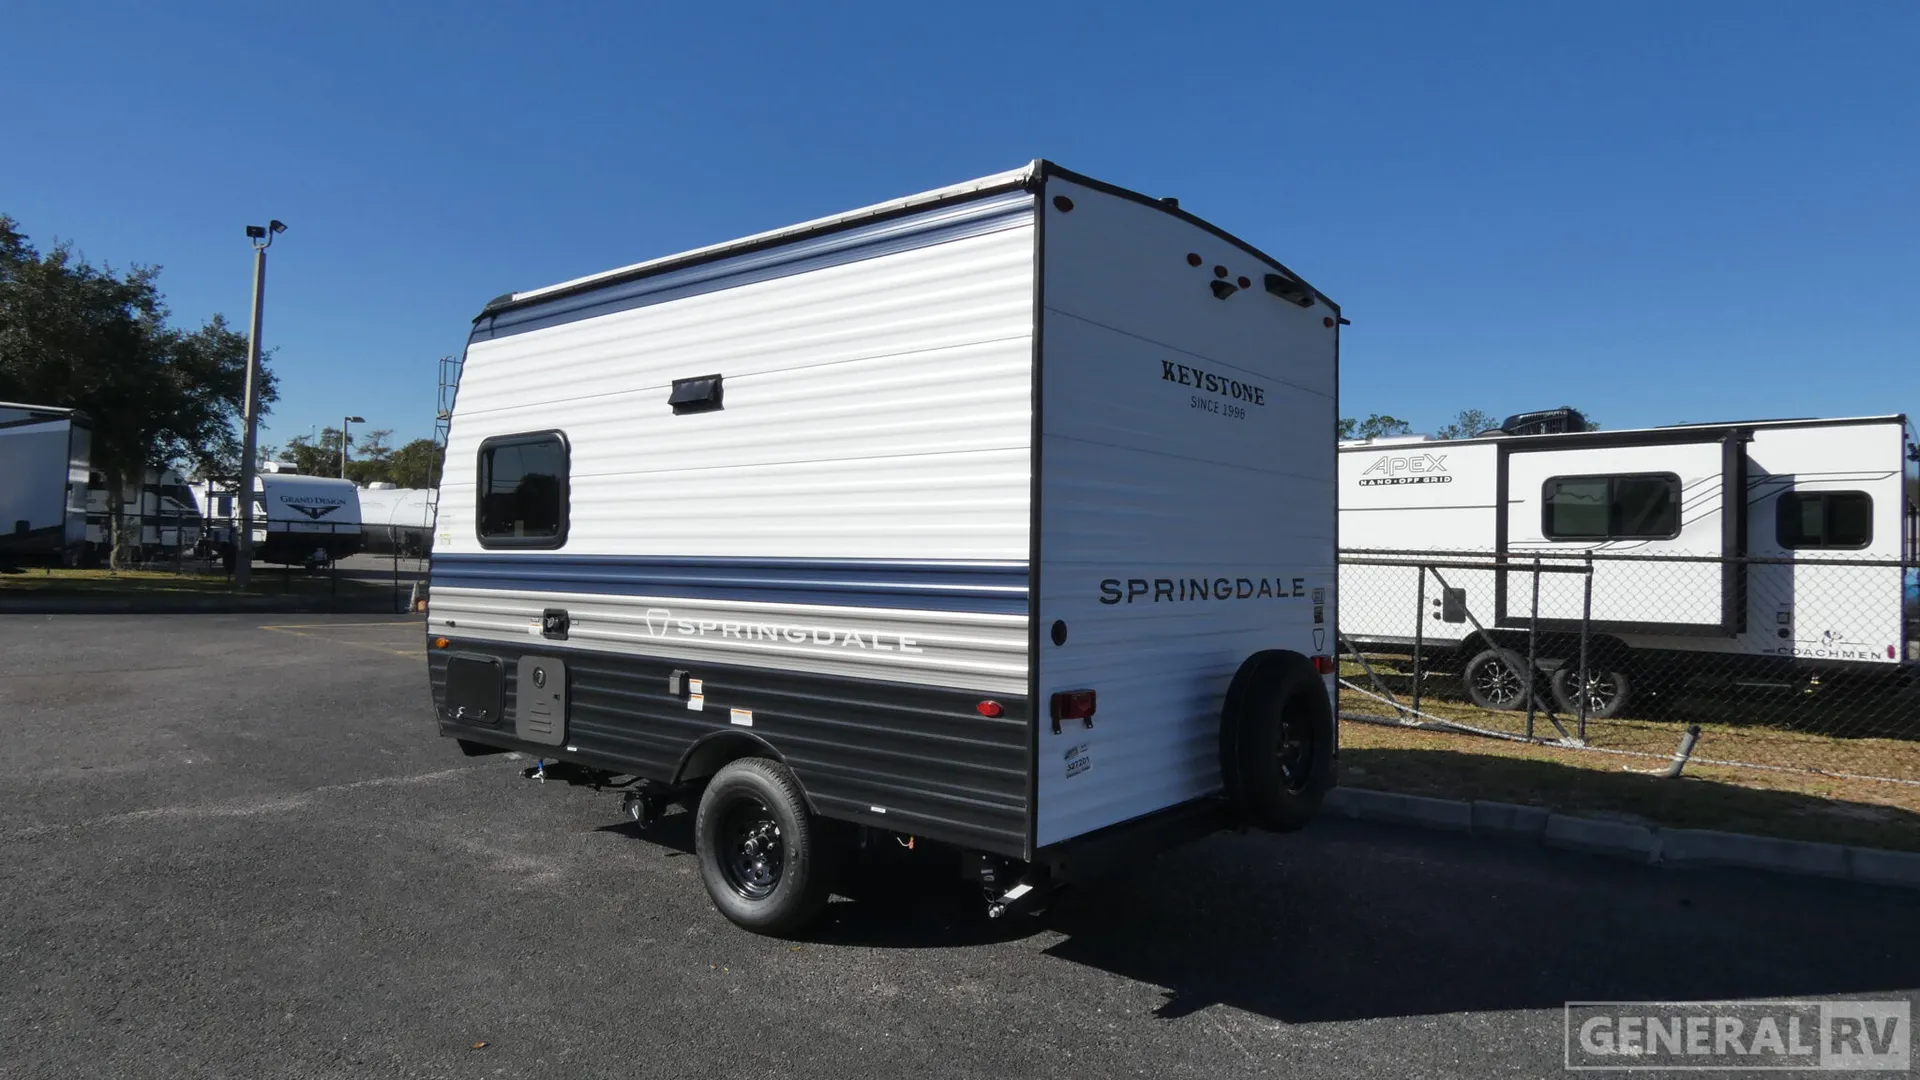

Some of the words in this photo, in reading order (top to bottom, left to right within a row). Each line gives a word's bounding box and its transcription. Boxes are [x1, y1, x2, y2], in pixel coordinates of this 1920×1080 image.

[1161, 359, 1265, 406] KEYSTONE
[1190, 395, 1219, 414] SINCE
[1362, 453, 1447, 476] APEX
[280, 495, 314, 504] GRAND
[315, 496, 346, 505] DESIGN
[1099, 577, 1305, 605] SPRINGDALE
[677, 618, 924, 653] SPRINGDALE
[1777, 647, 1881, 660] COACHMEN
